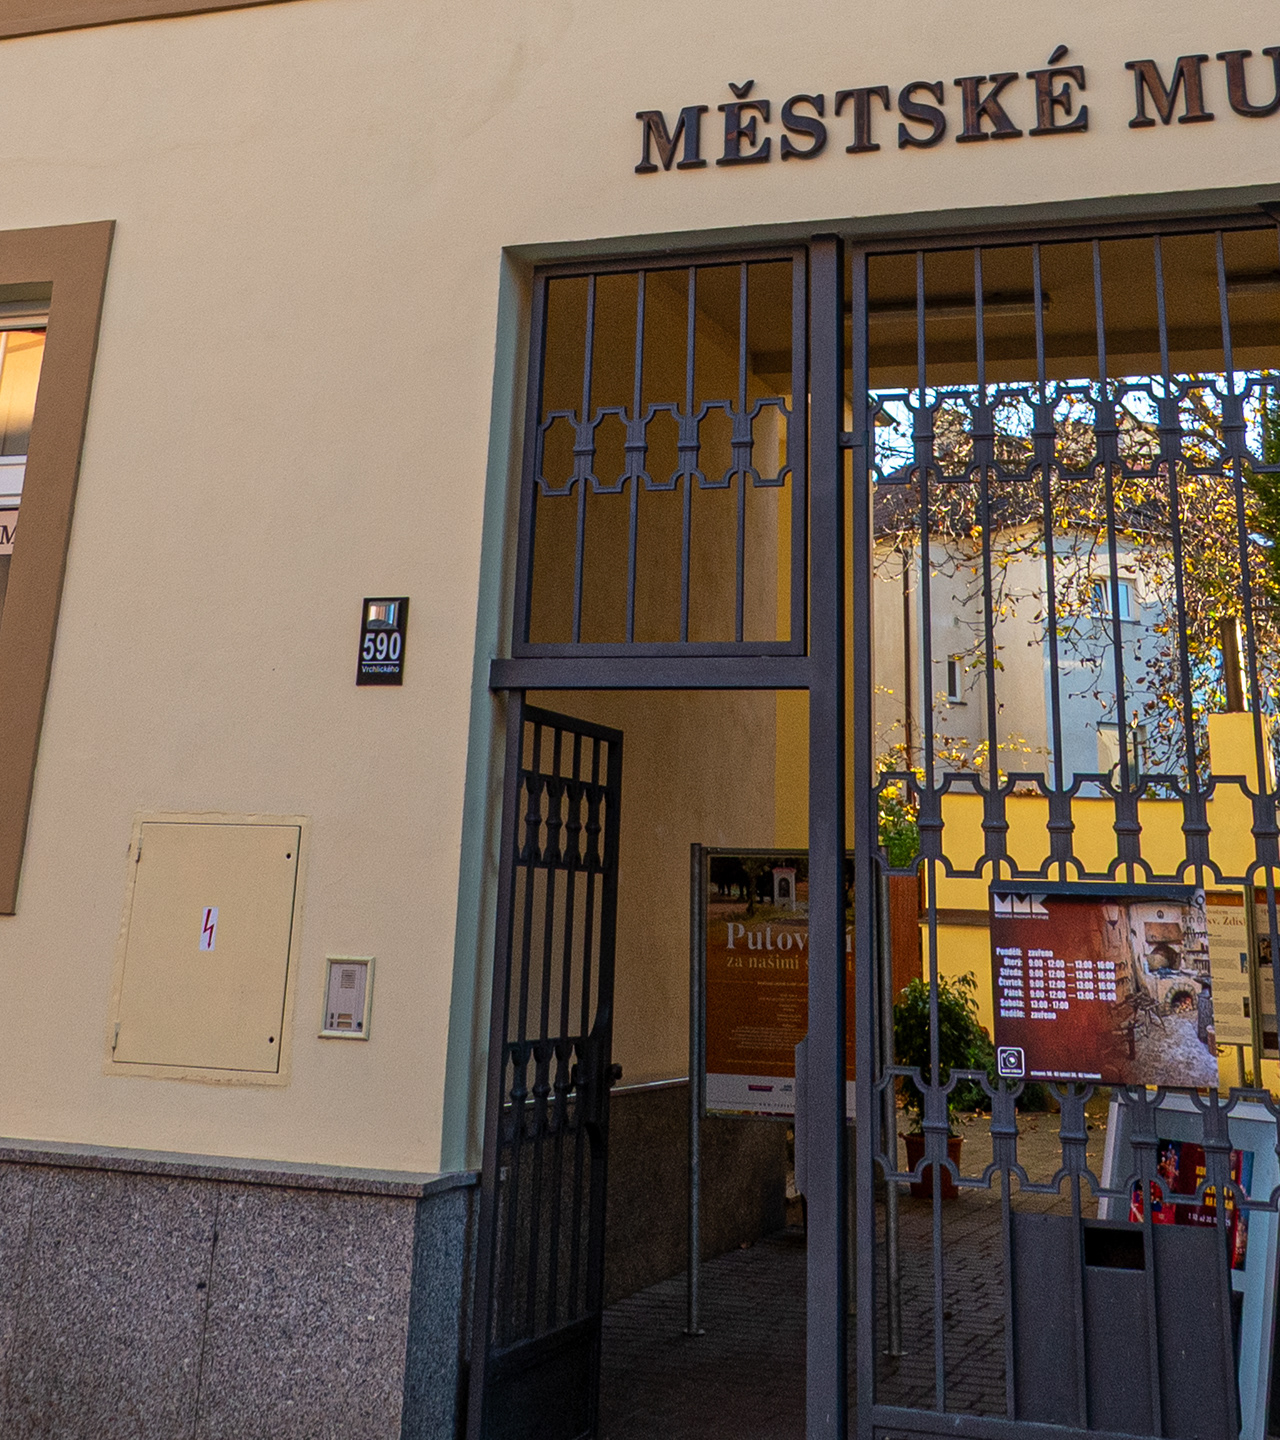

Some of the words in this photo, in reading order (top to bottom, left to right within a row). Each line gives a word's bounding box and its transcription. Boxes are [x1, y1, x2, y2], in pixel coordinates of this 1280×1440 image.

[634, 44, 1090, 174] MĚSTSKÉ
[362, 632, 401, 660] 590
[362, 665, 400, 673] Vrchlického
[994, 893, 1049, 913] MMK
[726, 922, 853, 952] Putoví
[727, 956, 743, 968] za
[749, 954, 800, 970] našimi
